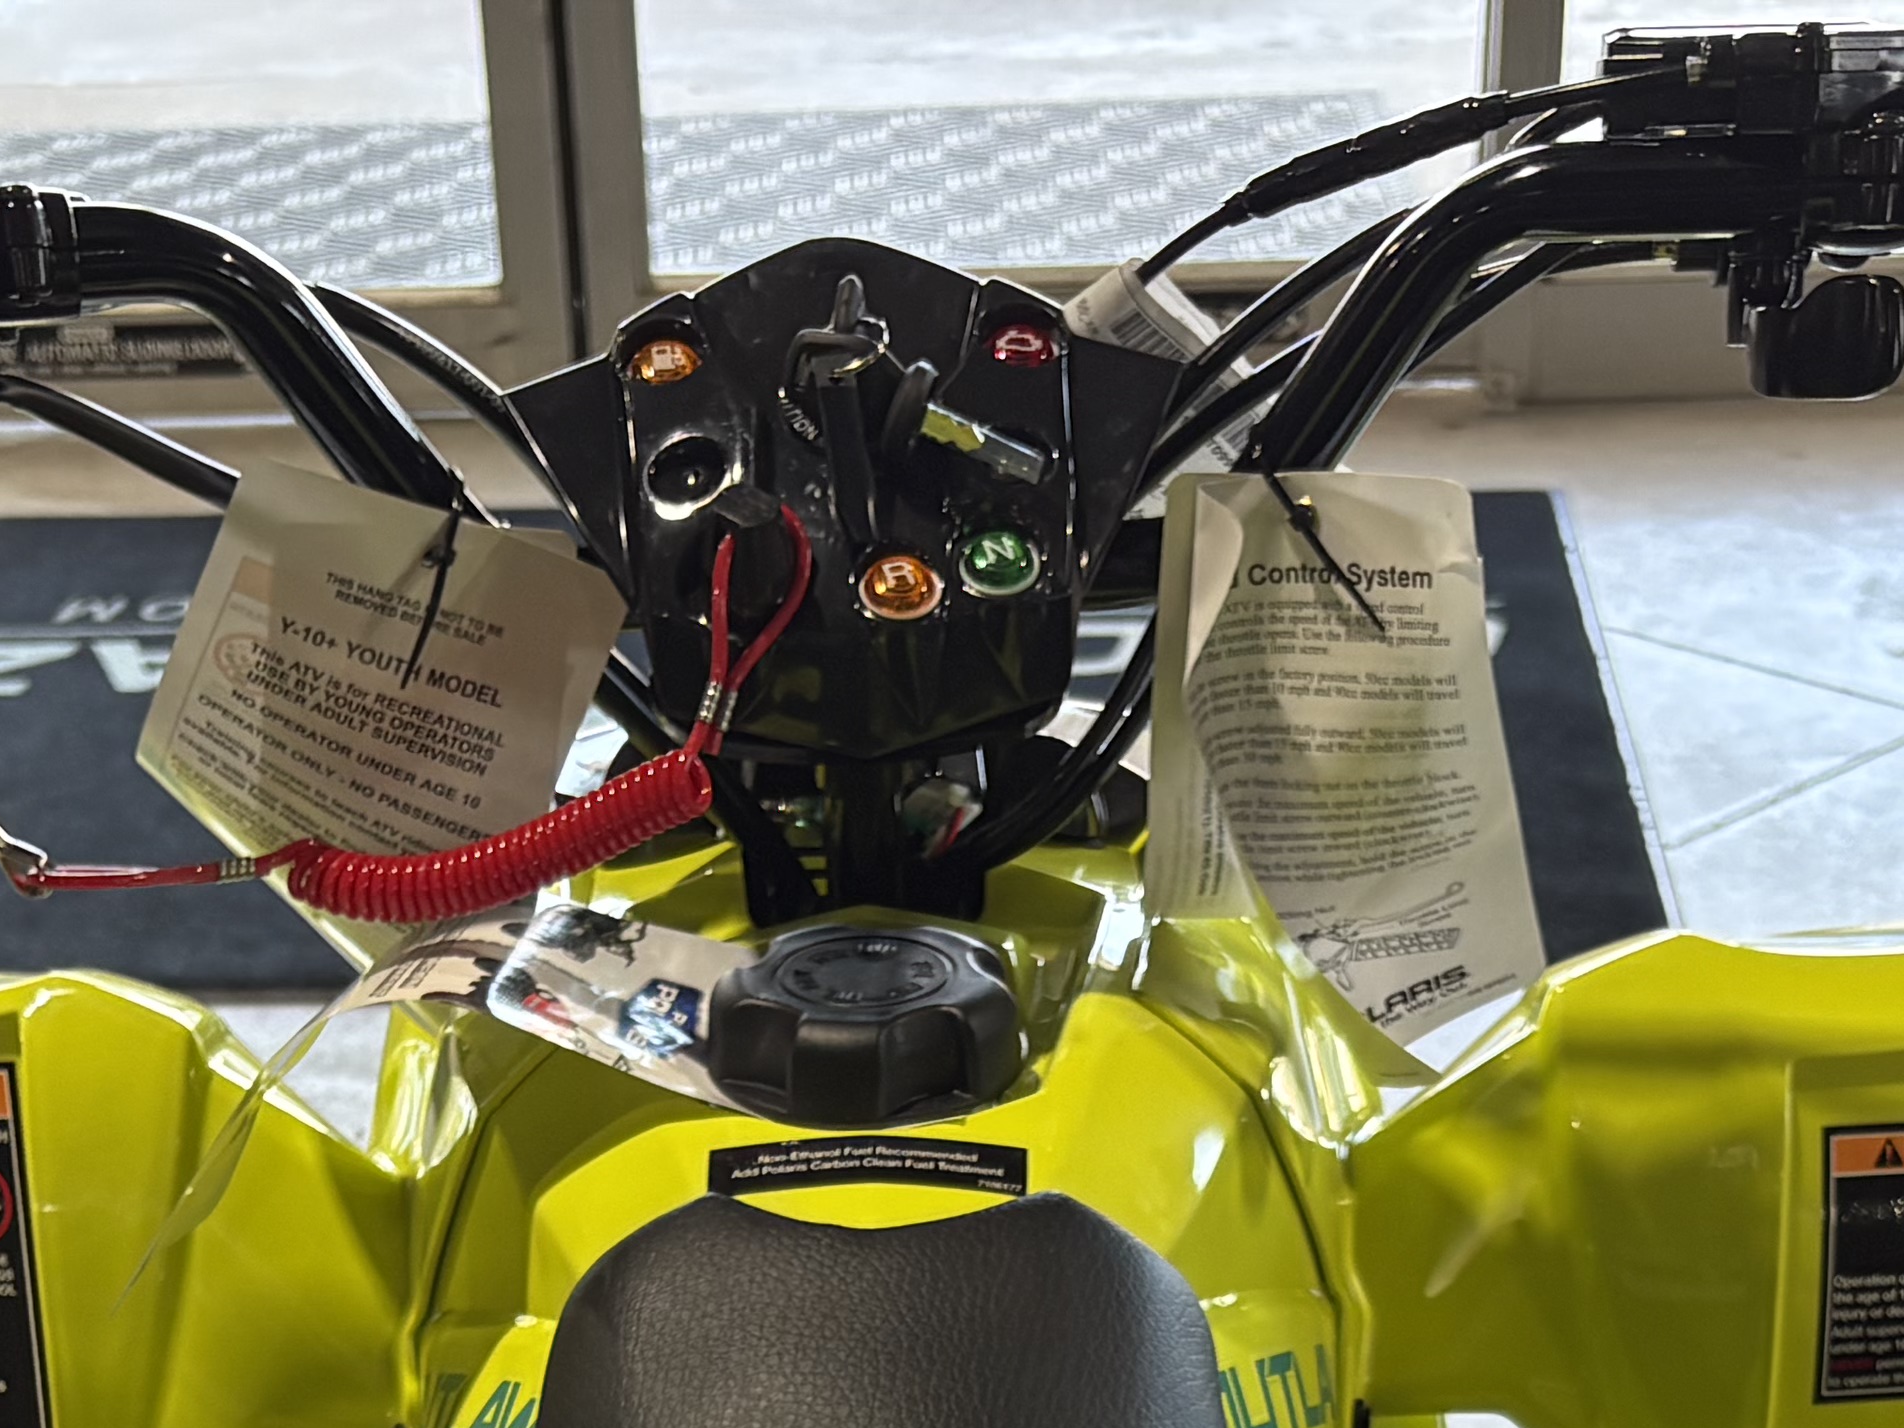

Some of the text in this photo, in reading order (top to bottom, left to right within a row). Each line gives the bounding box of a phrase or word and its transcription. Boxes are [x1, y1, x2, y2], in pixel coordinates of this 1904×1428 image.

[881, 562, 916, 586] R
[982, 536, 1016, 563] N
[1347, 563, 1433, 592] System
[279, 617, 503, 708] Y-10+ YOUTH MODEL
[400, 609, 451, 635] BEFRE
[246, 671, 489, 777] UNDER ADULT SUPERVISION
[251, 642, 505, 747] This ATV is for RECREATIONAL
[255, 661, 497, 761] USE BY YOUNG OPERATORS
[198, 696, 285, 755] OPERATOR
[291, 750, 334, 781] ONLY
[349, 780, 374, 799] NO
[231, 690, 482, 809] NO OPERATOR UNDER AGE 10
[1362, 964, 1469, 1023] LARIS
